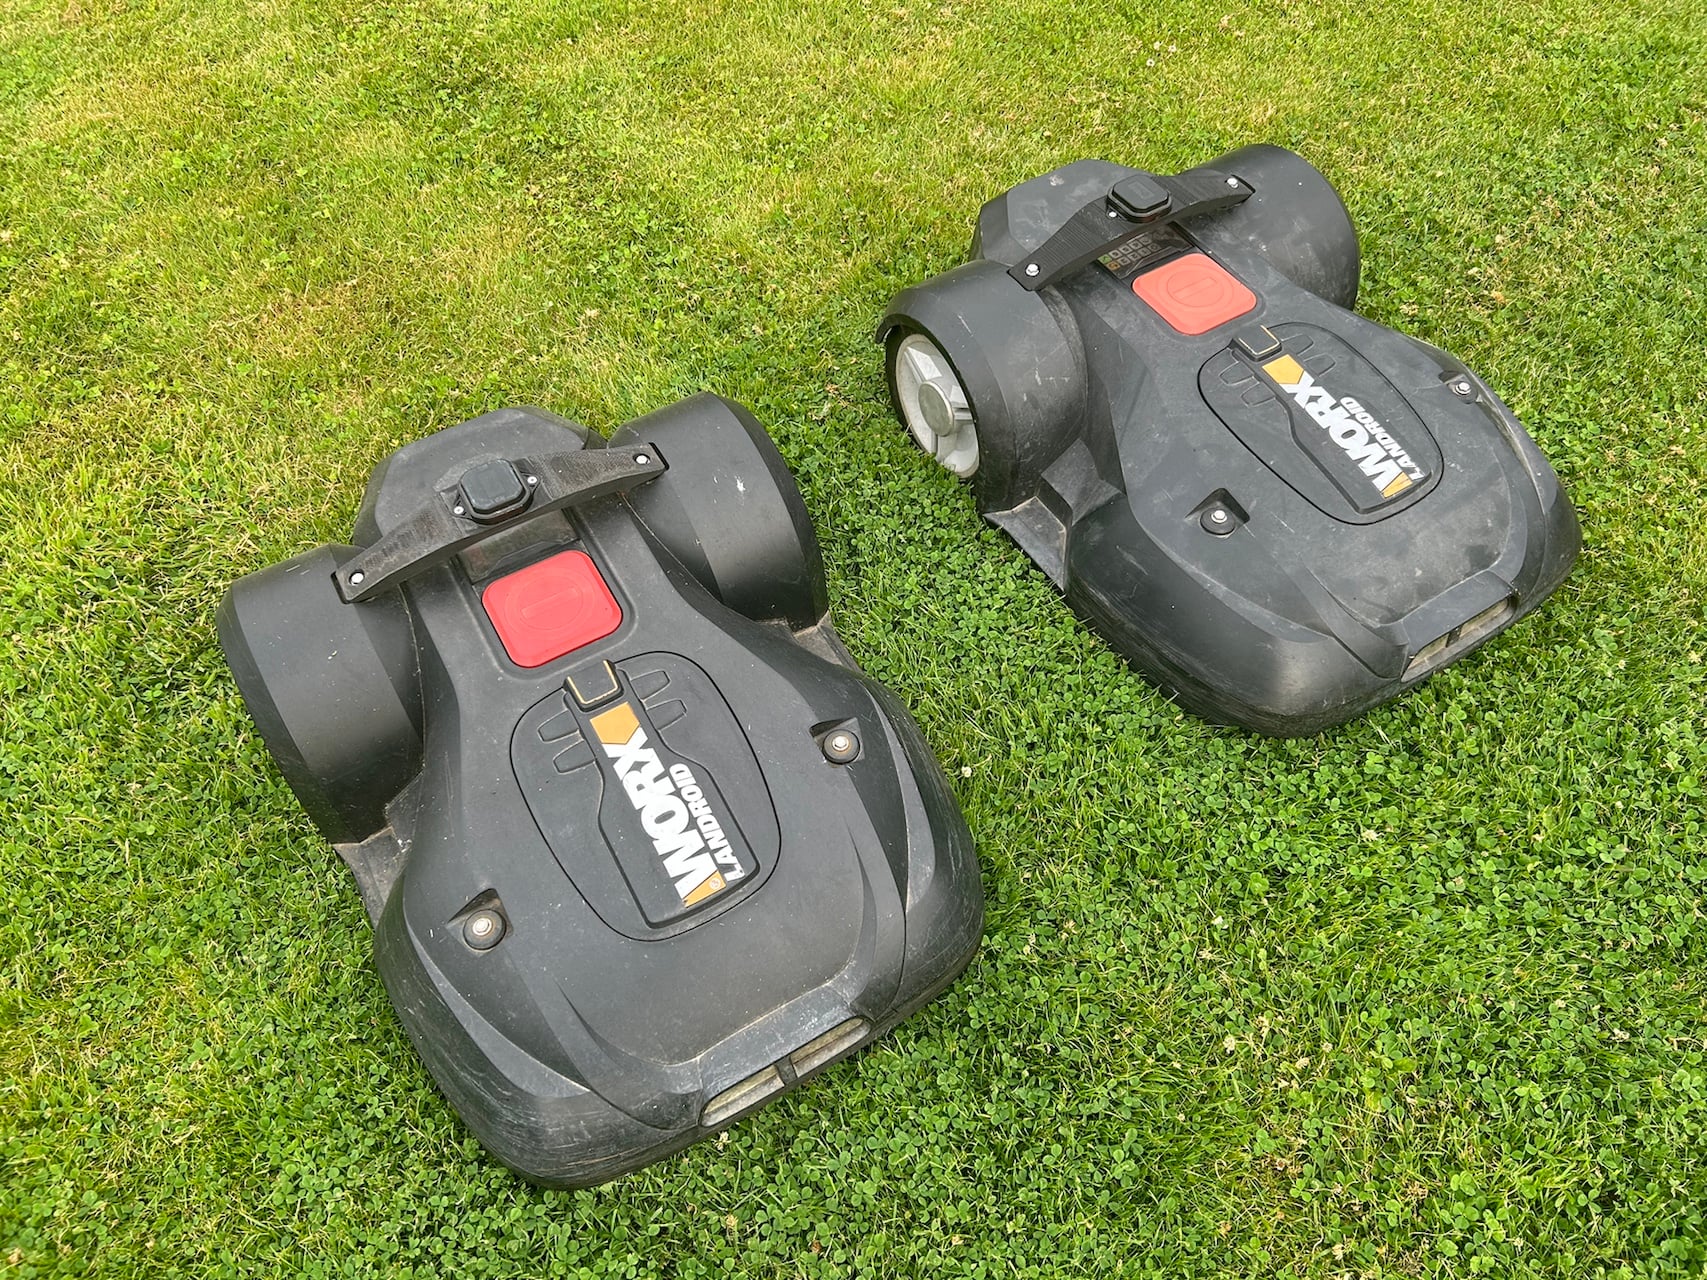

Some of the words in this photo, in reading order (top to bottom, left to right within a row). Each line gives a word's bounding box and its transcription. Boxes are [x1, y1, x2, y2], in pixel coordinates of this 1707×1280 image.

[1279, 370, 1412, 498] WORX
[1340, 396, 1425, 481] LANDROID
[601, 726, 726, 908] WORX
[668, 763, 745, 882] LANDROID
